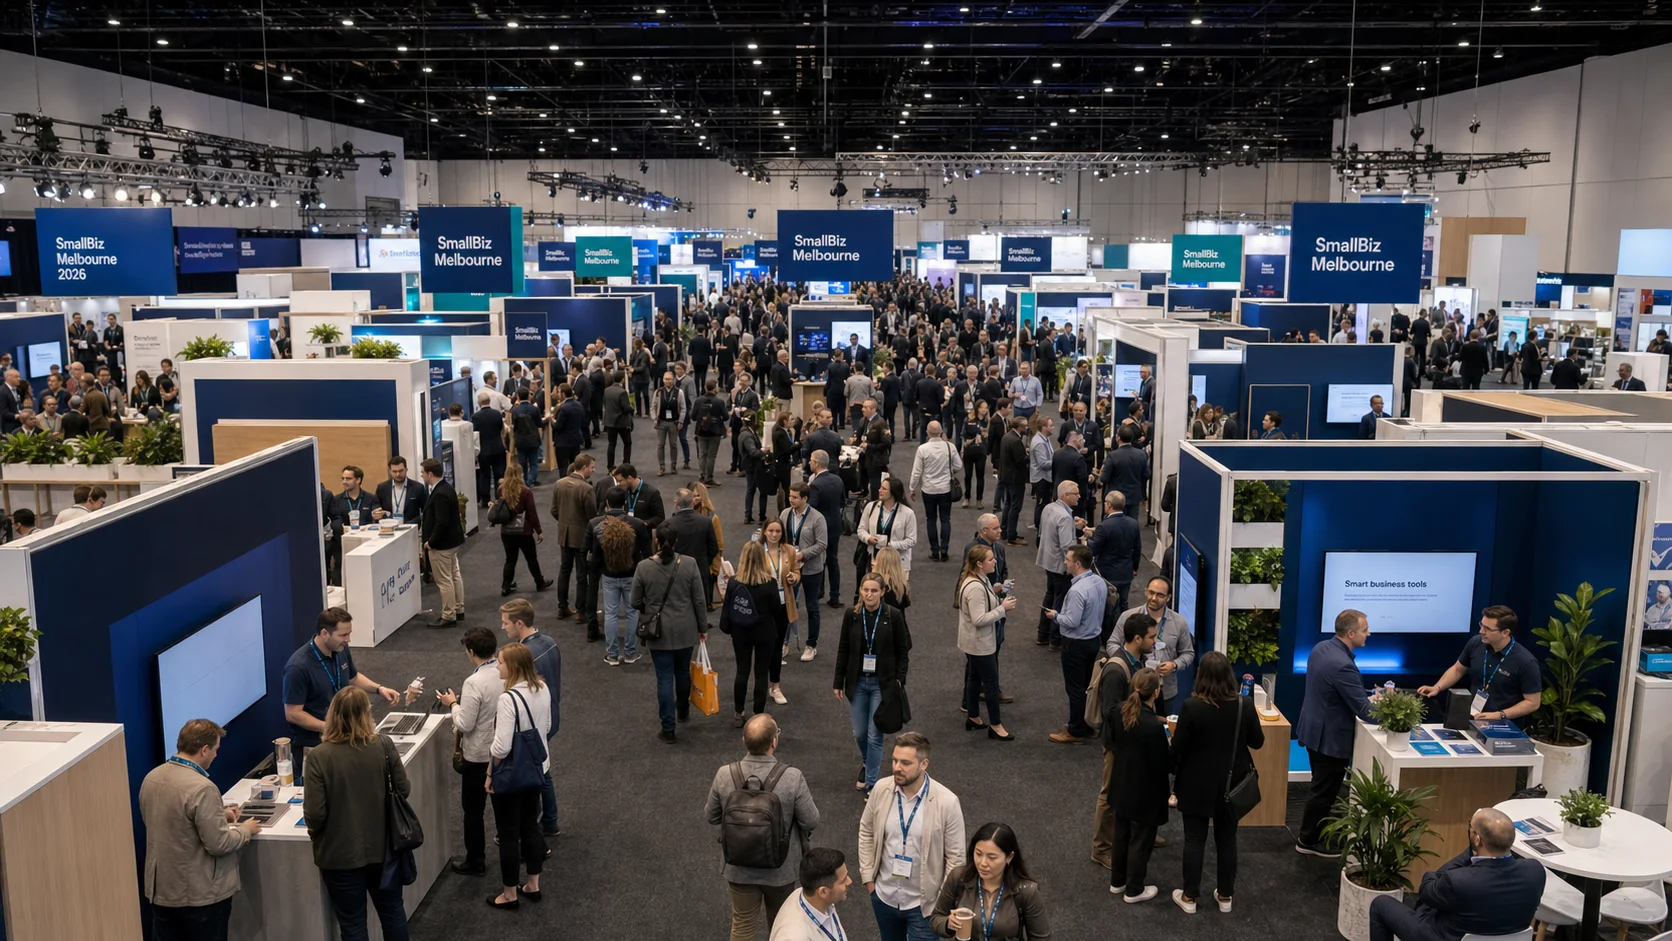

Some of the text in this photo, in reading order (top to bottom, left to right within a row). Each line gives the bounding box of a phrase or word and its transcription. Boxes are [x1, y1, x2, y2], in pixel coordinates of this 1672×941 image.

[55, 236, 105, 250] SmallBiz
[437, 236, 492, 250] SmallBiz
[794, 234, 847, 247] SmallBiz
[1315, 236, 1382, 253] SmallBiz
[56, 252, 118, 265] Melbourne
[434, 253, 502, 266] Melbourne
[792, 249, 860, 262] Melbourne
[1183, 249, 1219, 259] SmallBiz
[1182, 259, 1225, 269] Melbourne
[1311, 256, 1395, 272] Melbourne
[57, 267, 87, 281] 2026
[1344, 580, 1428, 588] Smart business tools
